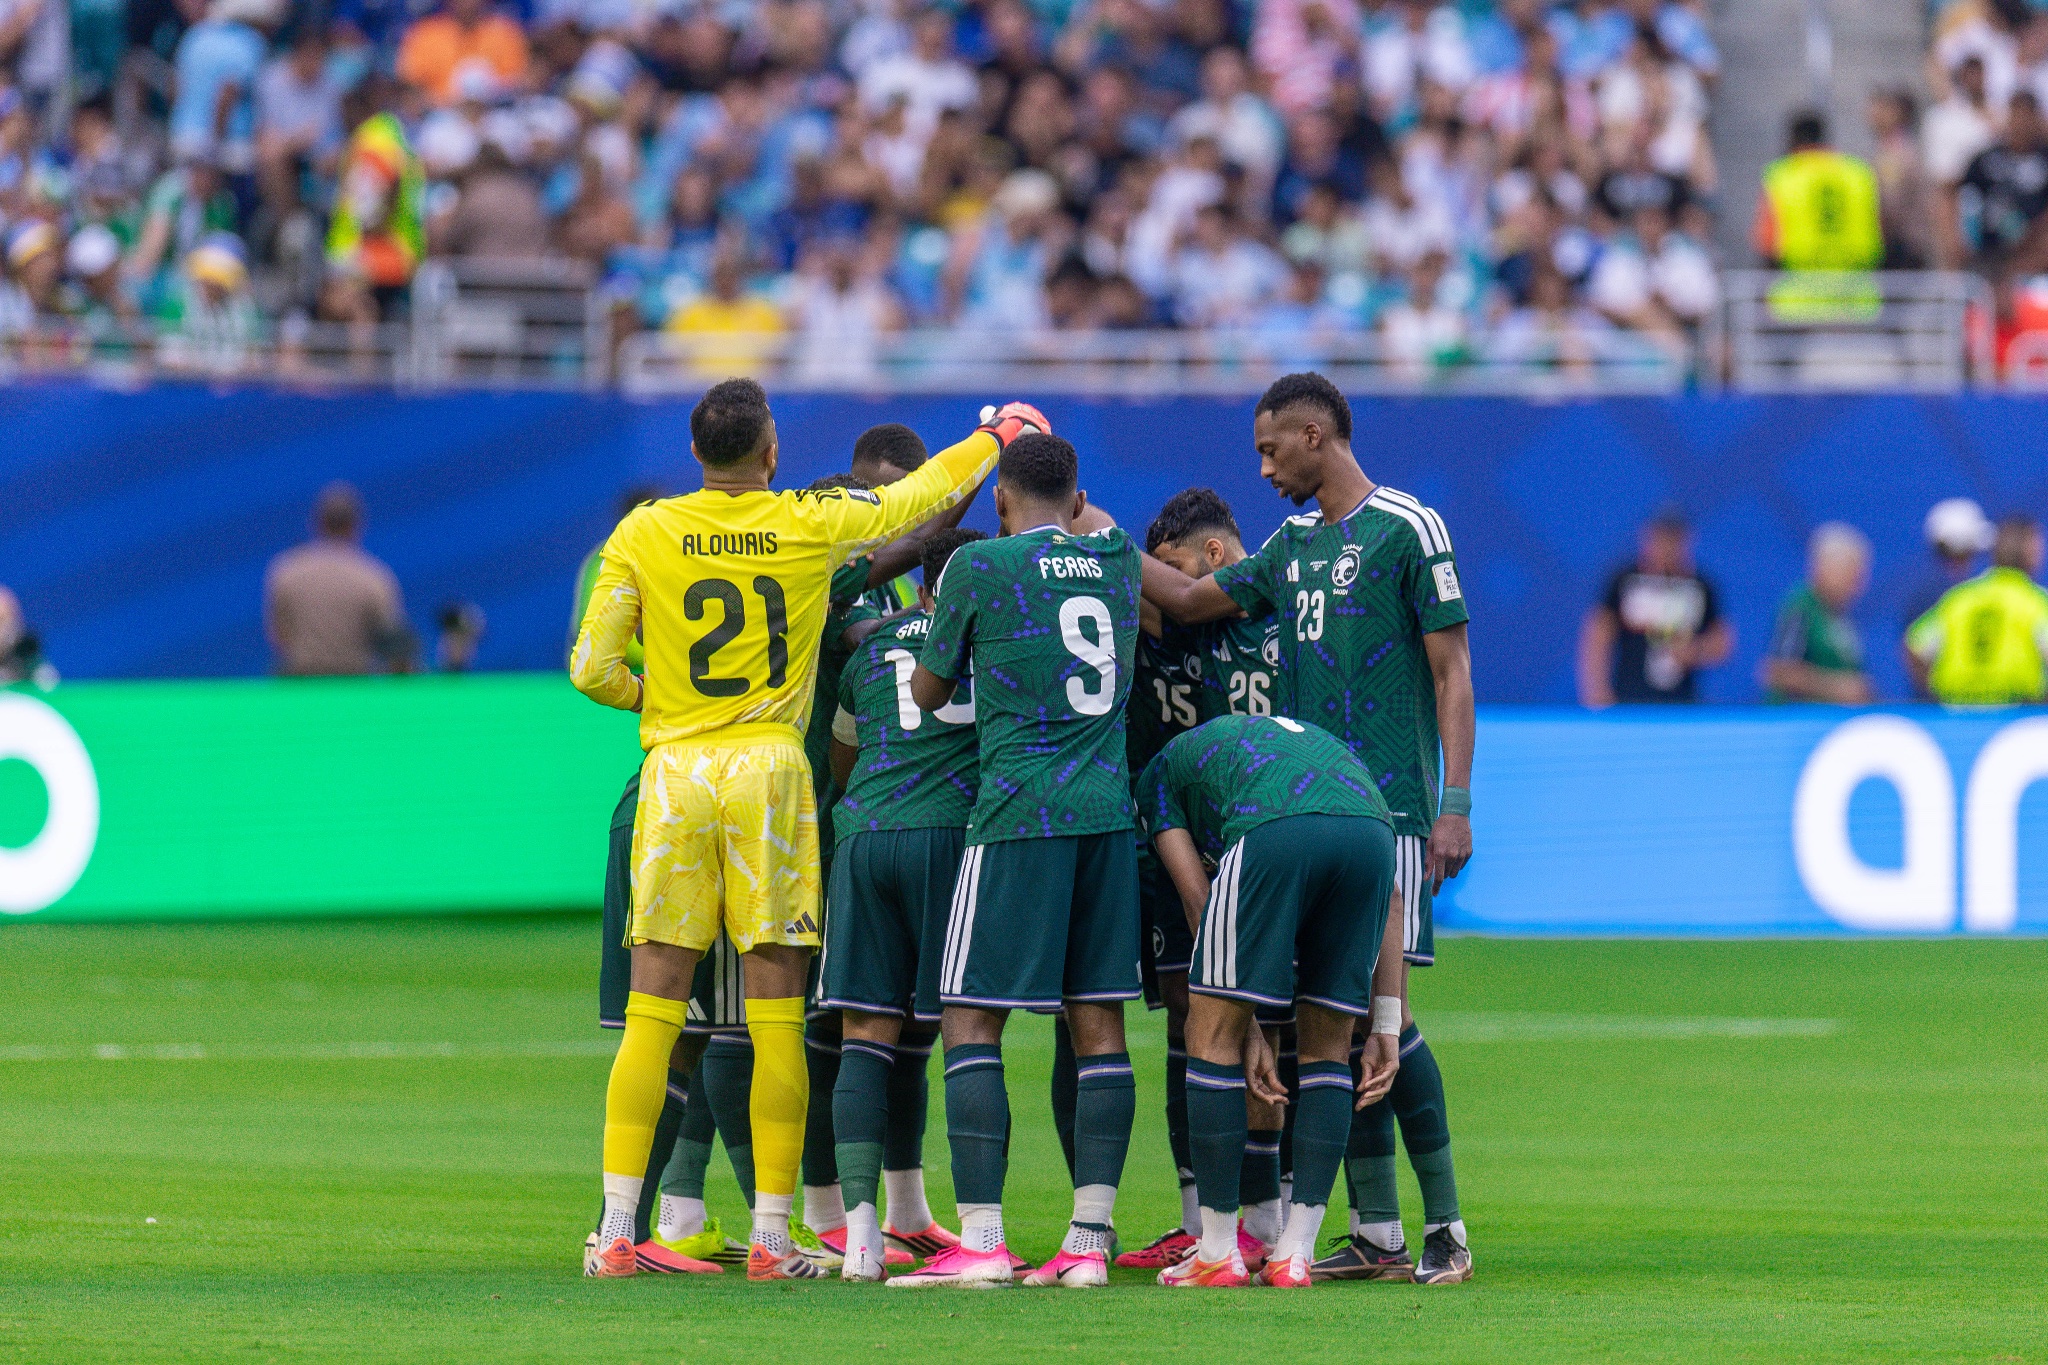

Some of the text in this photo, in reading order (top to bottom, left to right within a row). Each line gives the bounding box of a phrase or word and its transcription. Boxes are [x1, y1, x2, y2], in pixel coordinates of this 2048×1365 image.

[683, 531, 778, 556] ALOWAIS
[1038, 556, 1103, 579] FERAS
[683, 575, 789, 698] 21
[1296, 589, 1325, 642] 23
[1058, 595, 1116, 716] 9
[1153, 678, 1197, 727] 15
[1228, 670, 1271, 717] 26
